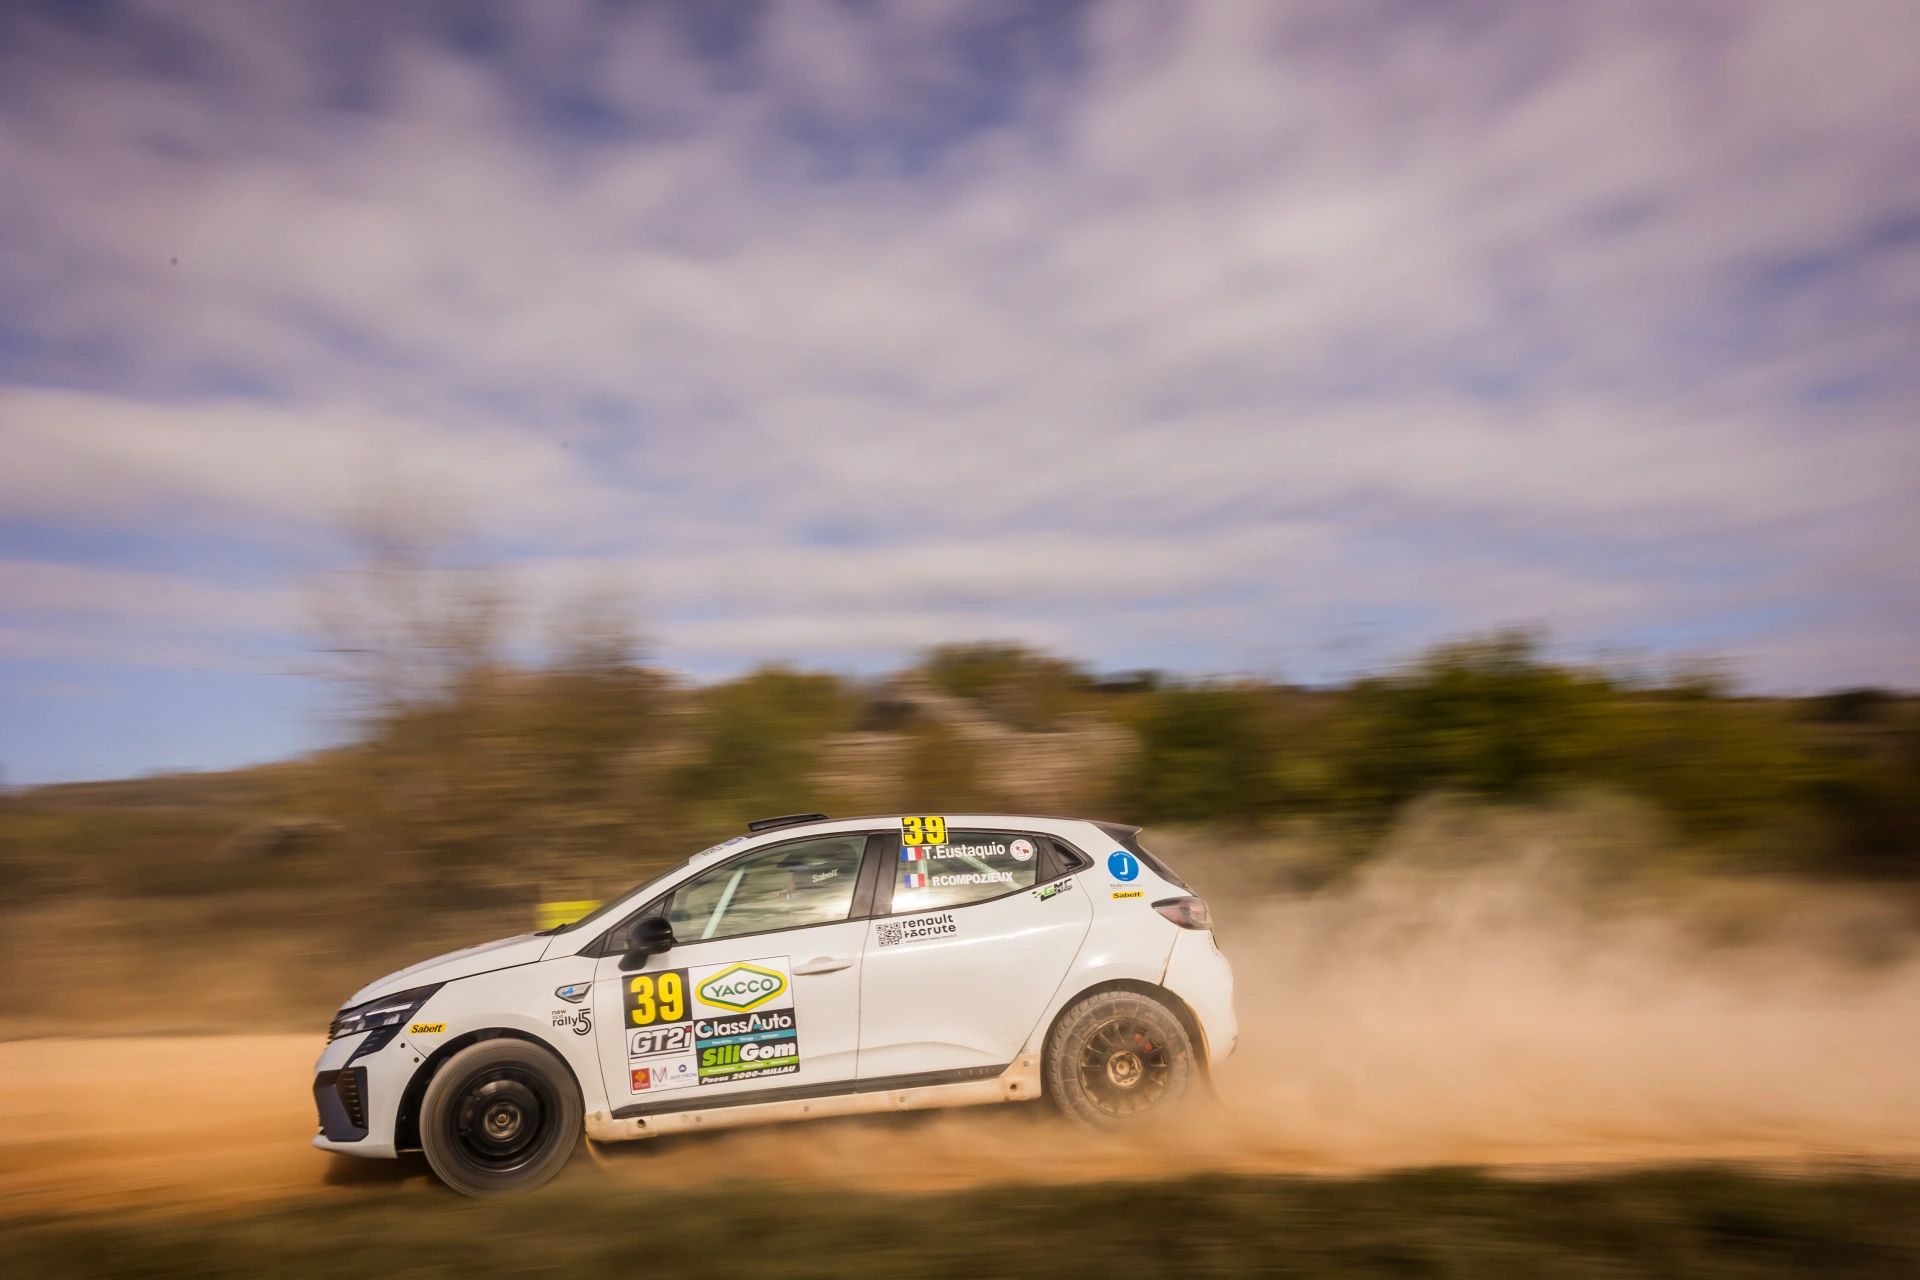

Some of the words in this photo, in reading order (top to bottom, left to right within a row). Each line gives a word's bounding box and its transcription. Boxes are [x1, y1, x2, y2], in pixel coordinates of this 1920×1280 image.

[903, 816, 945, 845] 39
[922, 842, 1005, 859] T.Eustaquio
[1120, 857, 1129, 875] J
[812, 869, 838, 883] Sabelt
[932, 872, 1013, 886] P.COMPOZIEUX
[902, 914, 954, 929] renault
[710, 978, 773, 997] YACCO
[630, 972, 684, 1025] 39
[411, 1024, 443, 1034] Sabelt
[631, 1026, 692, 1055] GT2i
[670, 1072, 697, 1080] AVEYRON
[702, 1075, 729, 1084] Pneus
[731, 1065, 796, 1080] 2000-MILLAU
